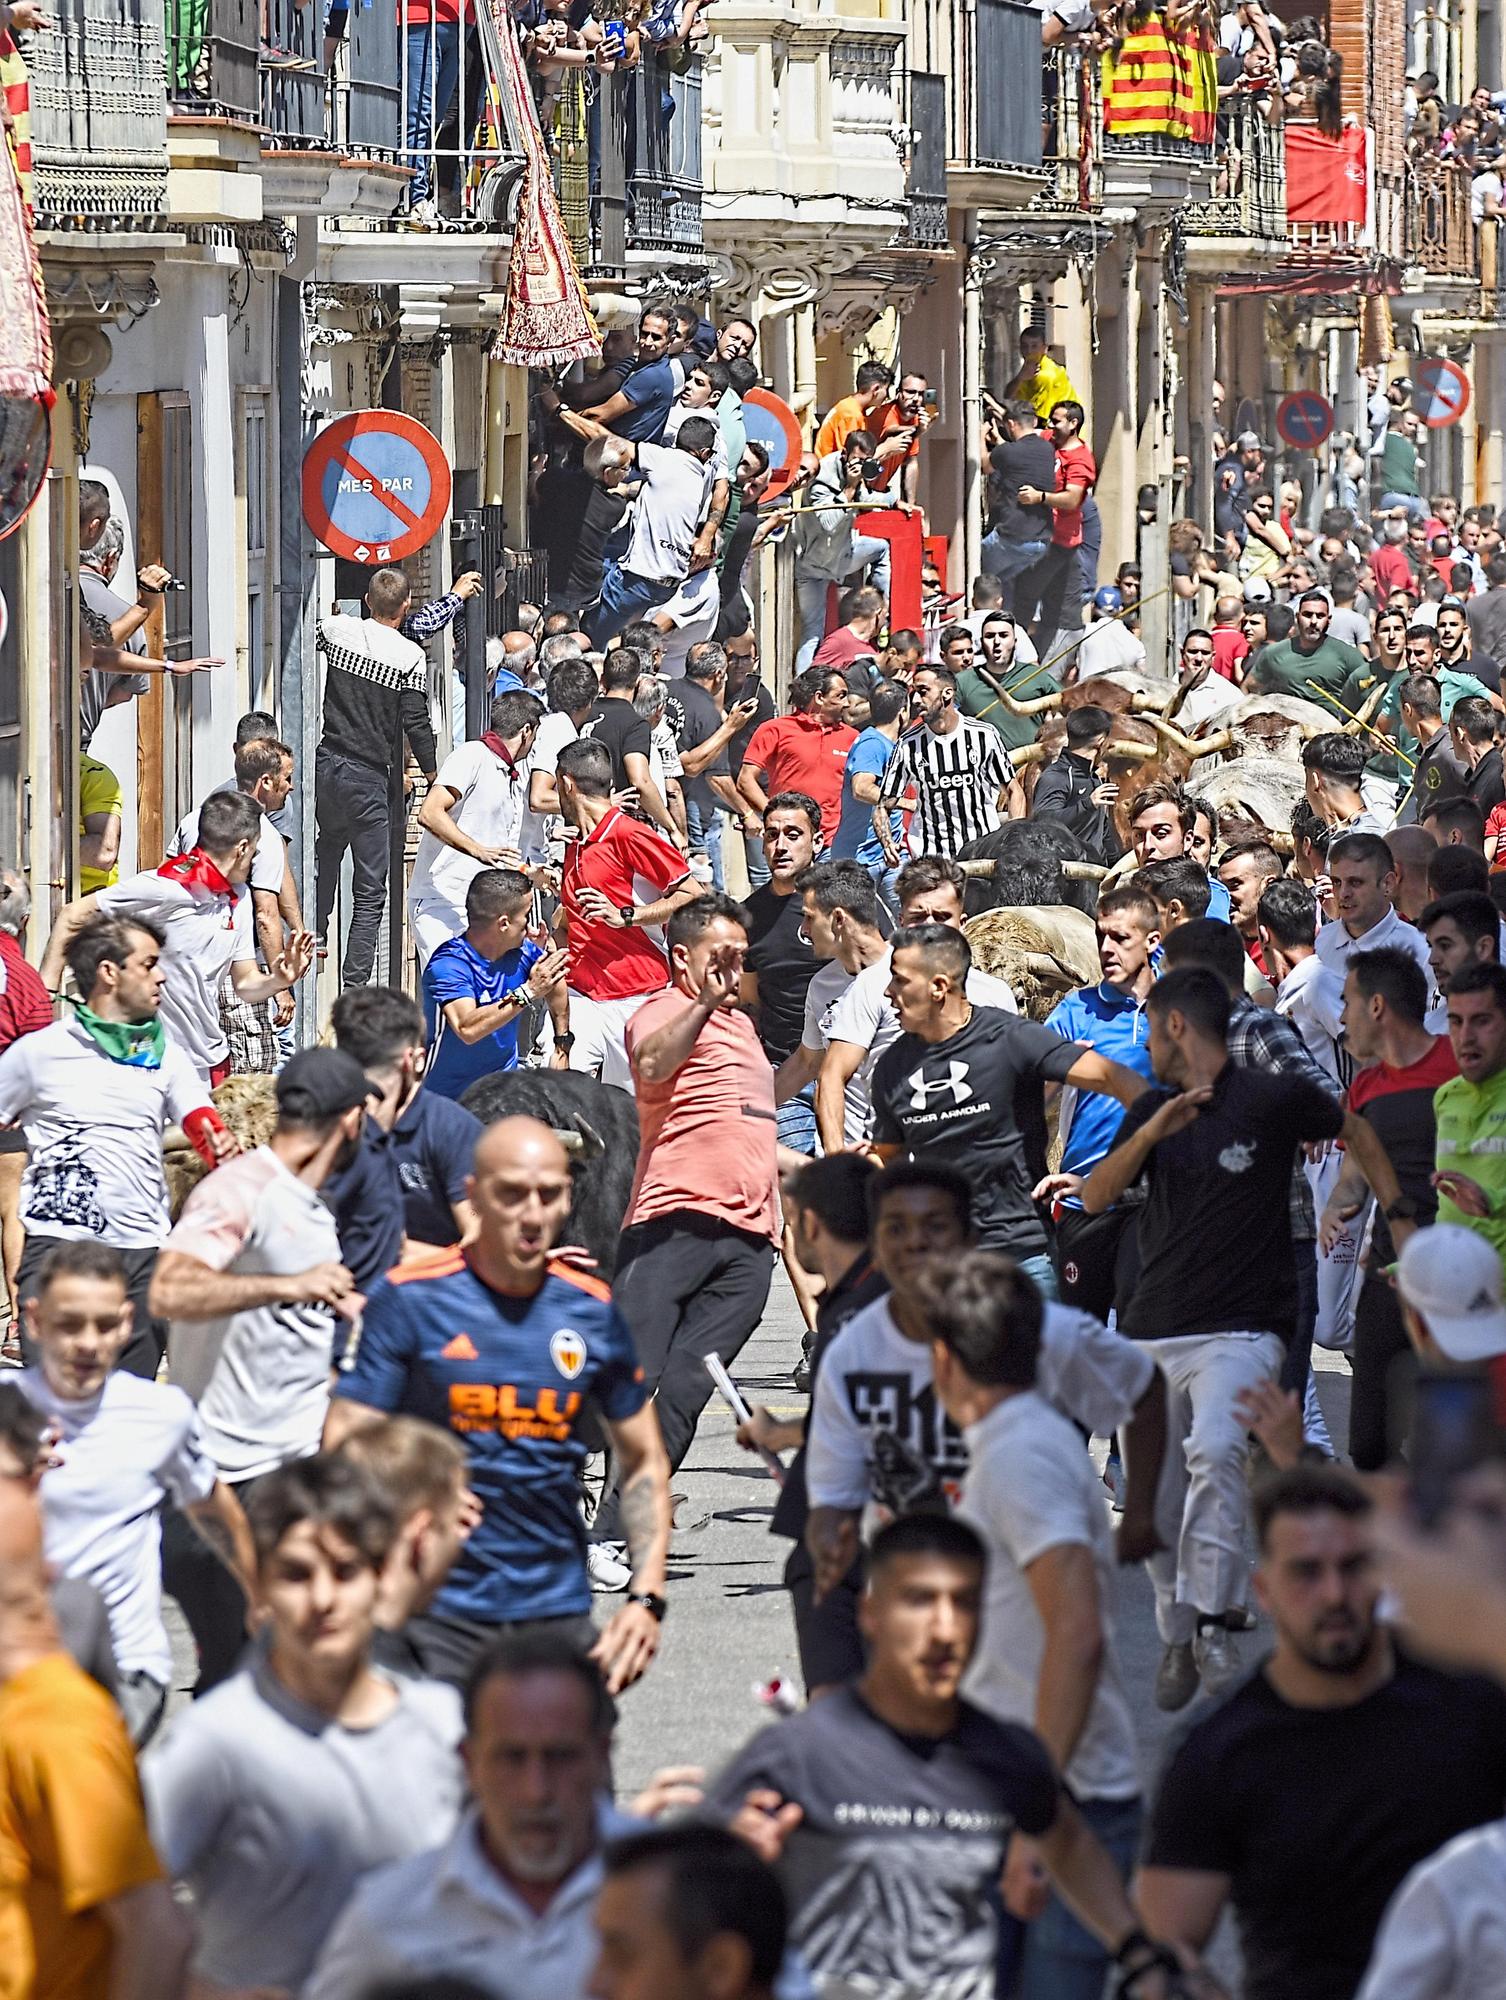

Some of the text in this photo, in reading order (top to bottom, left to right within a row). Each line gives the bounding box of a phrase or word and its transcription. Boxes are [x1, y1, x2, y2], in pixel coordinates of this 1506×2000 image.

[338, 477, 413, 493] MES PAR
[928, 773, 974, 790] Jeep
[902, 1102, 991, 1125] UNDER ARMOUR
[449, 1384, 582, 1425] BLU
